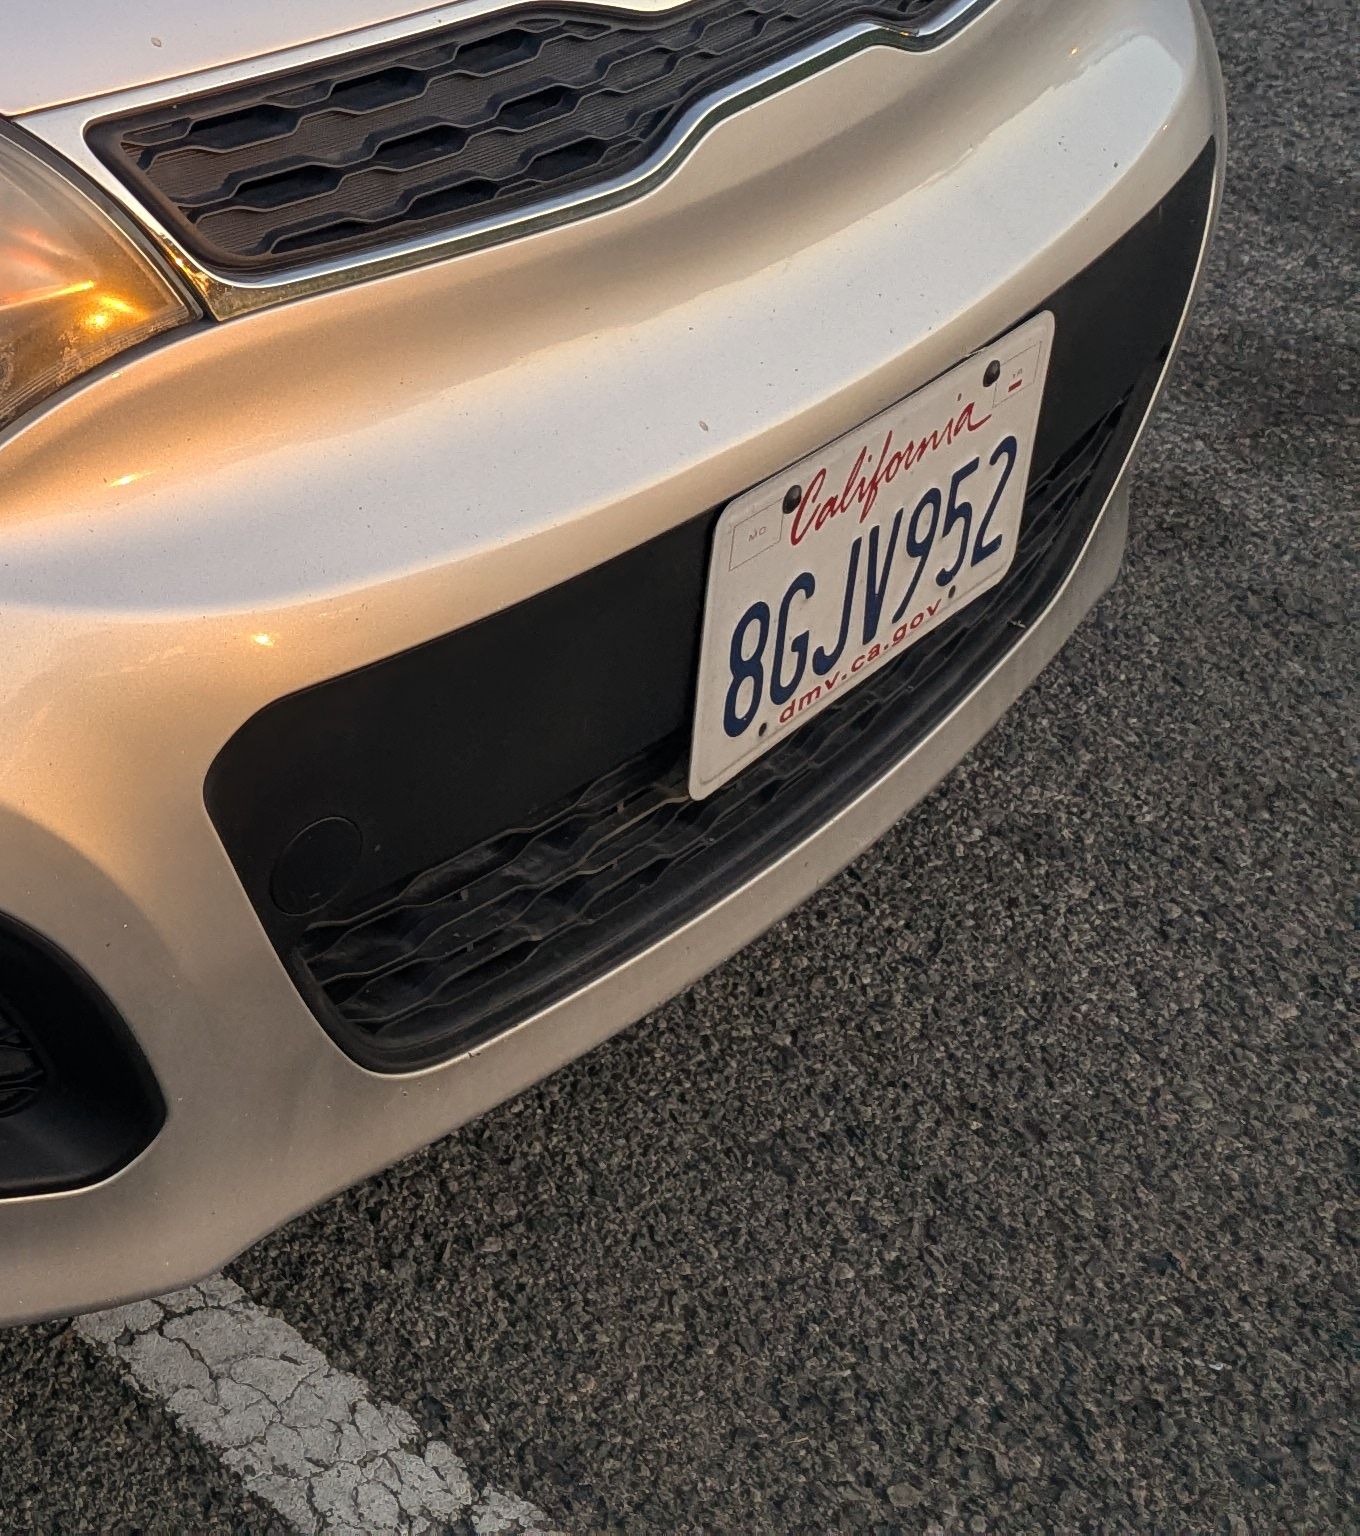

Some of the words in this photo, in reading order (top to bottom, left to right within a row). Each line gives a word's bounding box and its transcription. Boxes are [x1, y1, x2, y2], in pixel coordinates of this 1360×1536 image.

[790, 392, 993, 546] California
[723, 435, 1018, 738] 8GJV952
[779, 598, 942, 724] dmv.ca.gov
